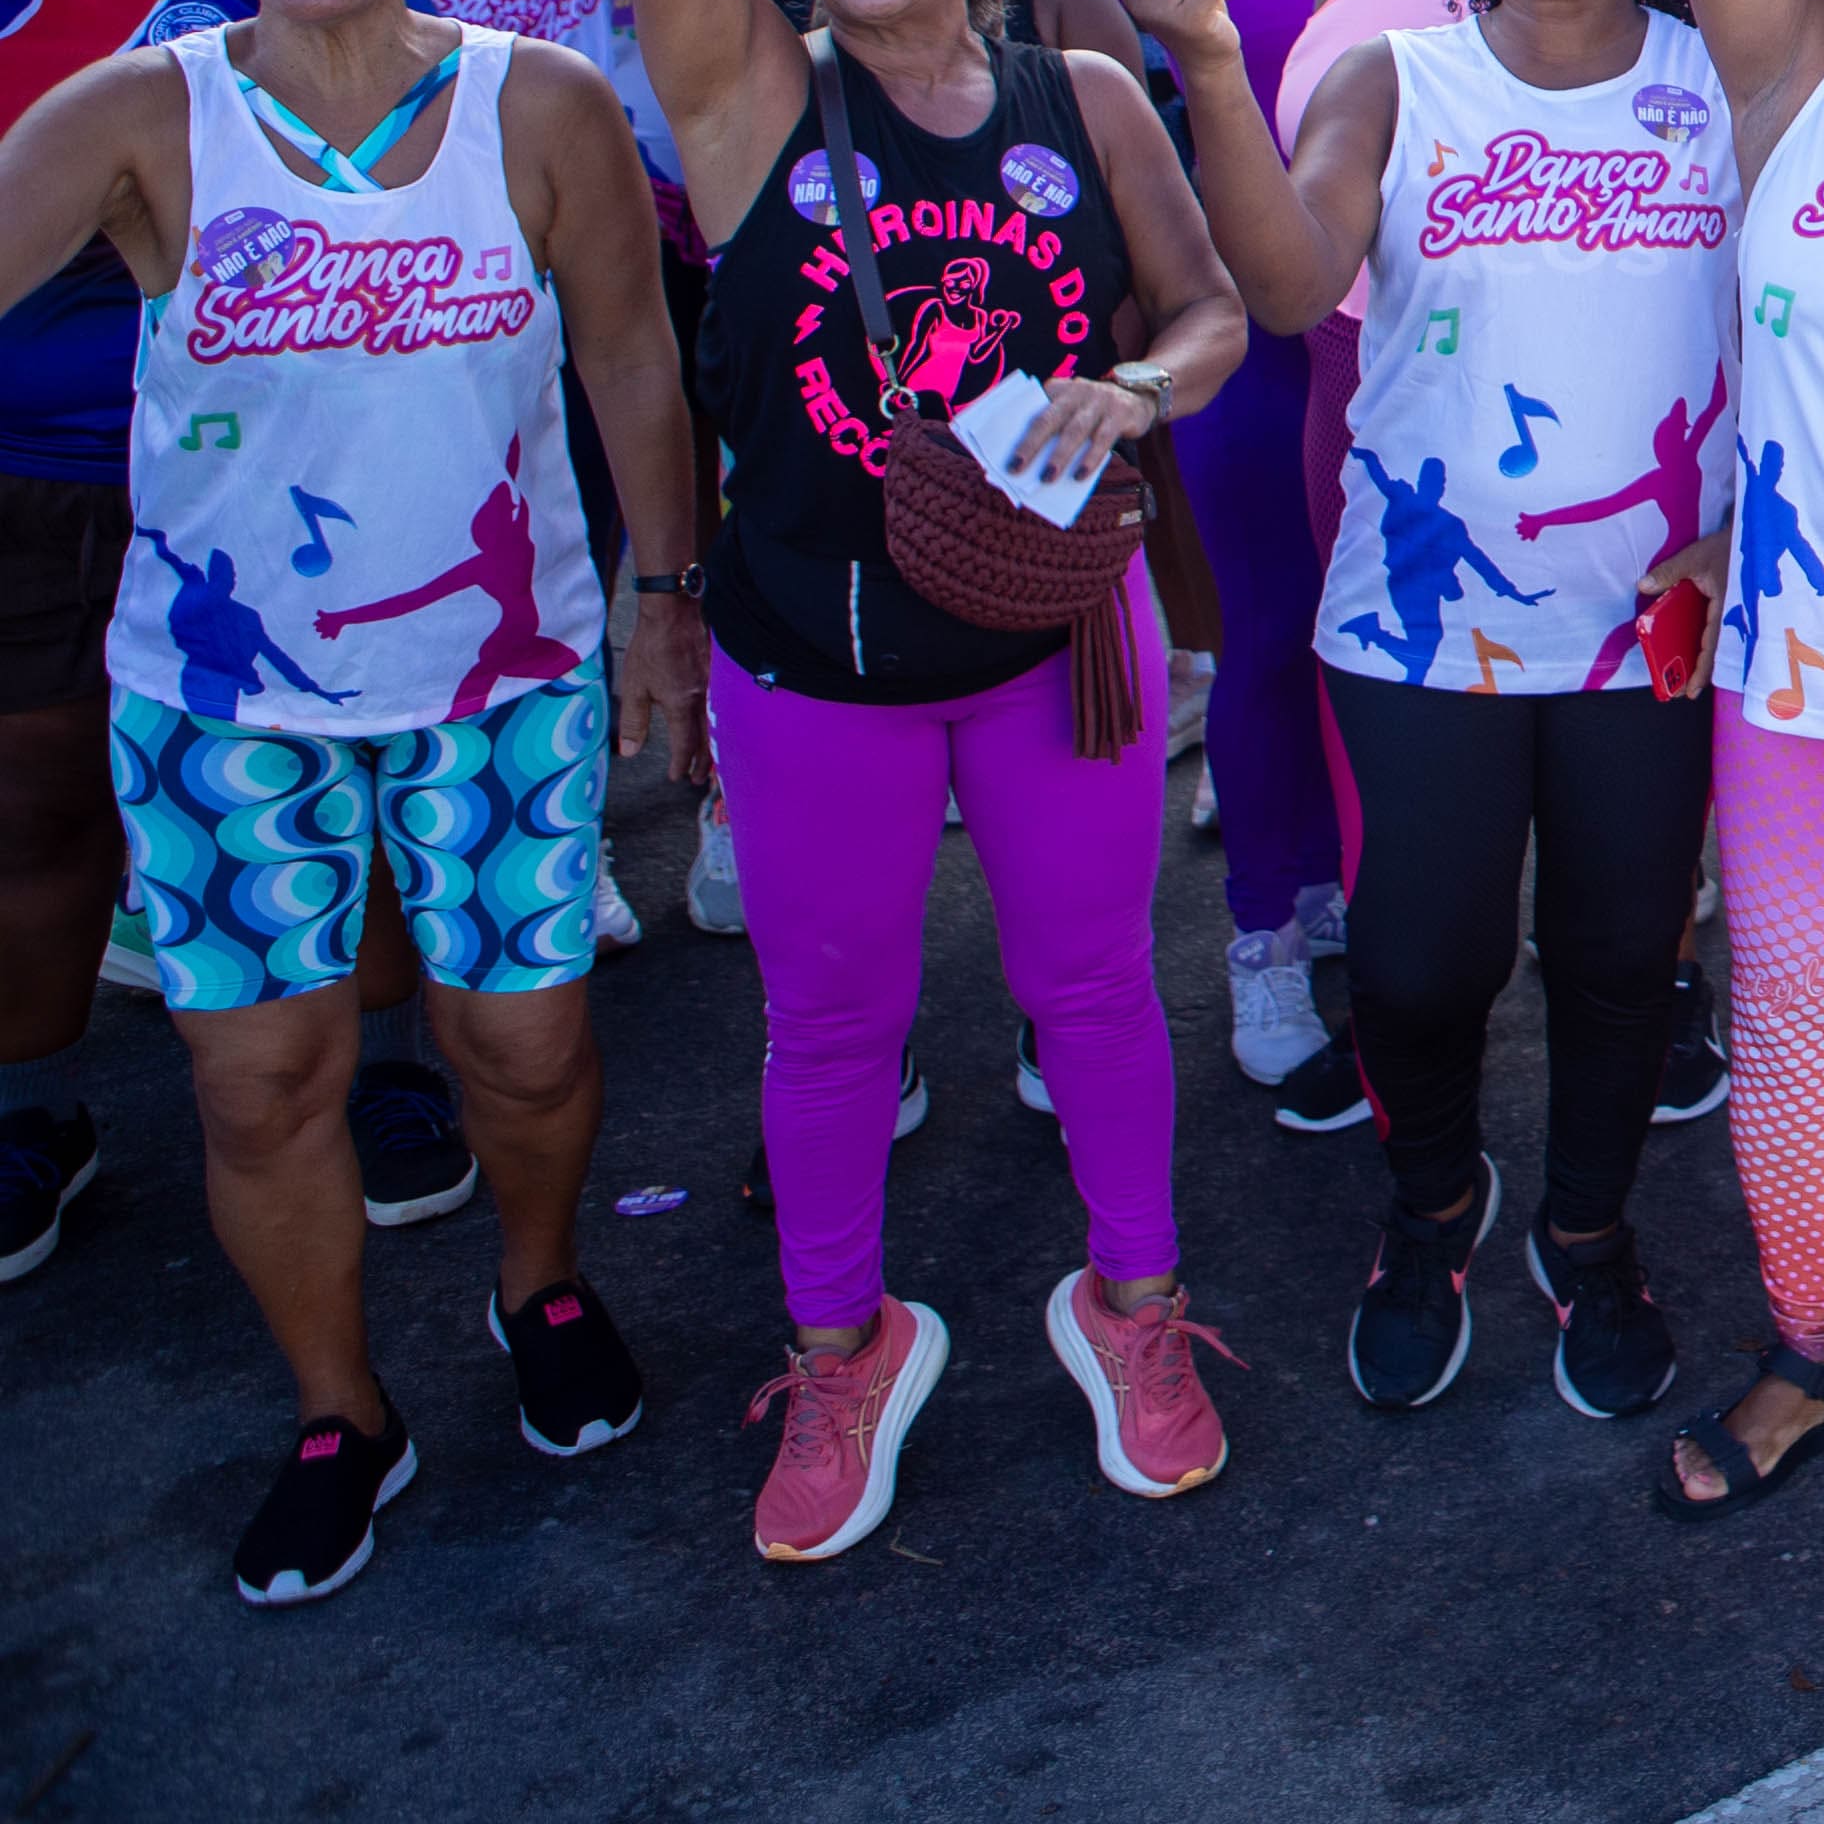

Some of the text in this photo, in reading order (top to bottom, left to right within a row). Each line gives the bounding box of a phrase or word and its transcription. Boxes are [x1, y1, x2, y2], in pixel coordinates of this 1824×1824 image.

[1637, 103, 1708, 125] NÃO É NÃO
[794, 178, 825, 204] NÃO
[1002, 159, 1075, 210] NÃO É NÃO
[1483, 136, 1663, 203] Dança
[1424, 180, 1722, 252] Santo Amaro
[211, 220, 292, 284] NÃO É NÃO
[254, 226, 458, 301] Dança
[193, 286, 530, 358] Santo Amaro
[1049, 267, 1091, 345] DO
